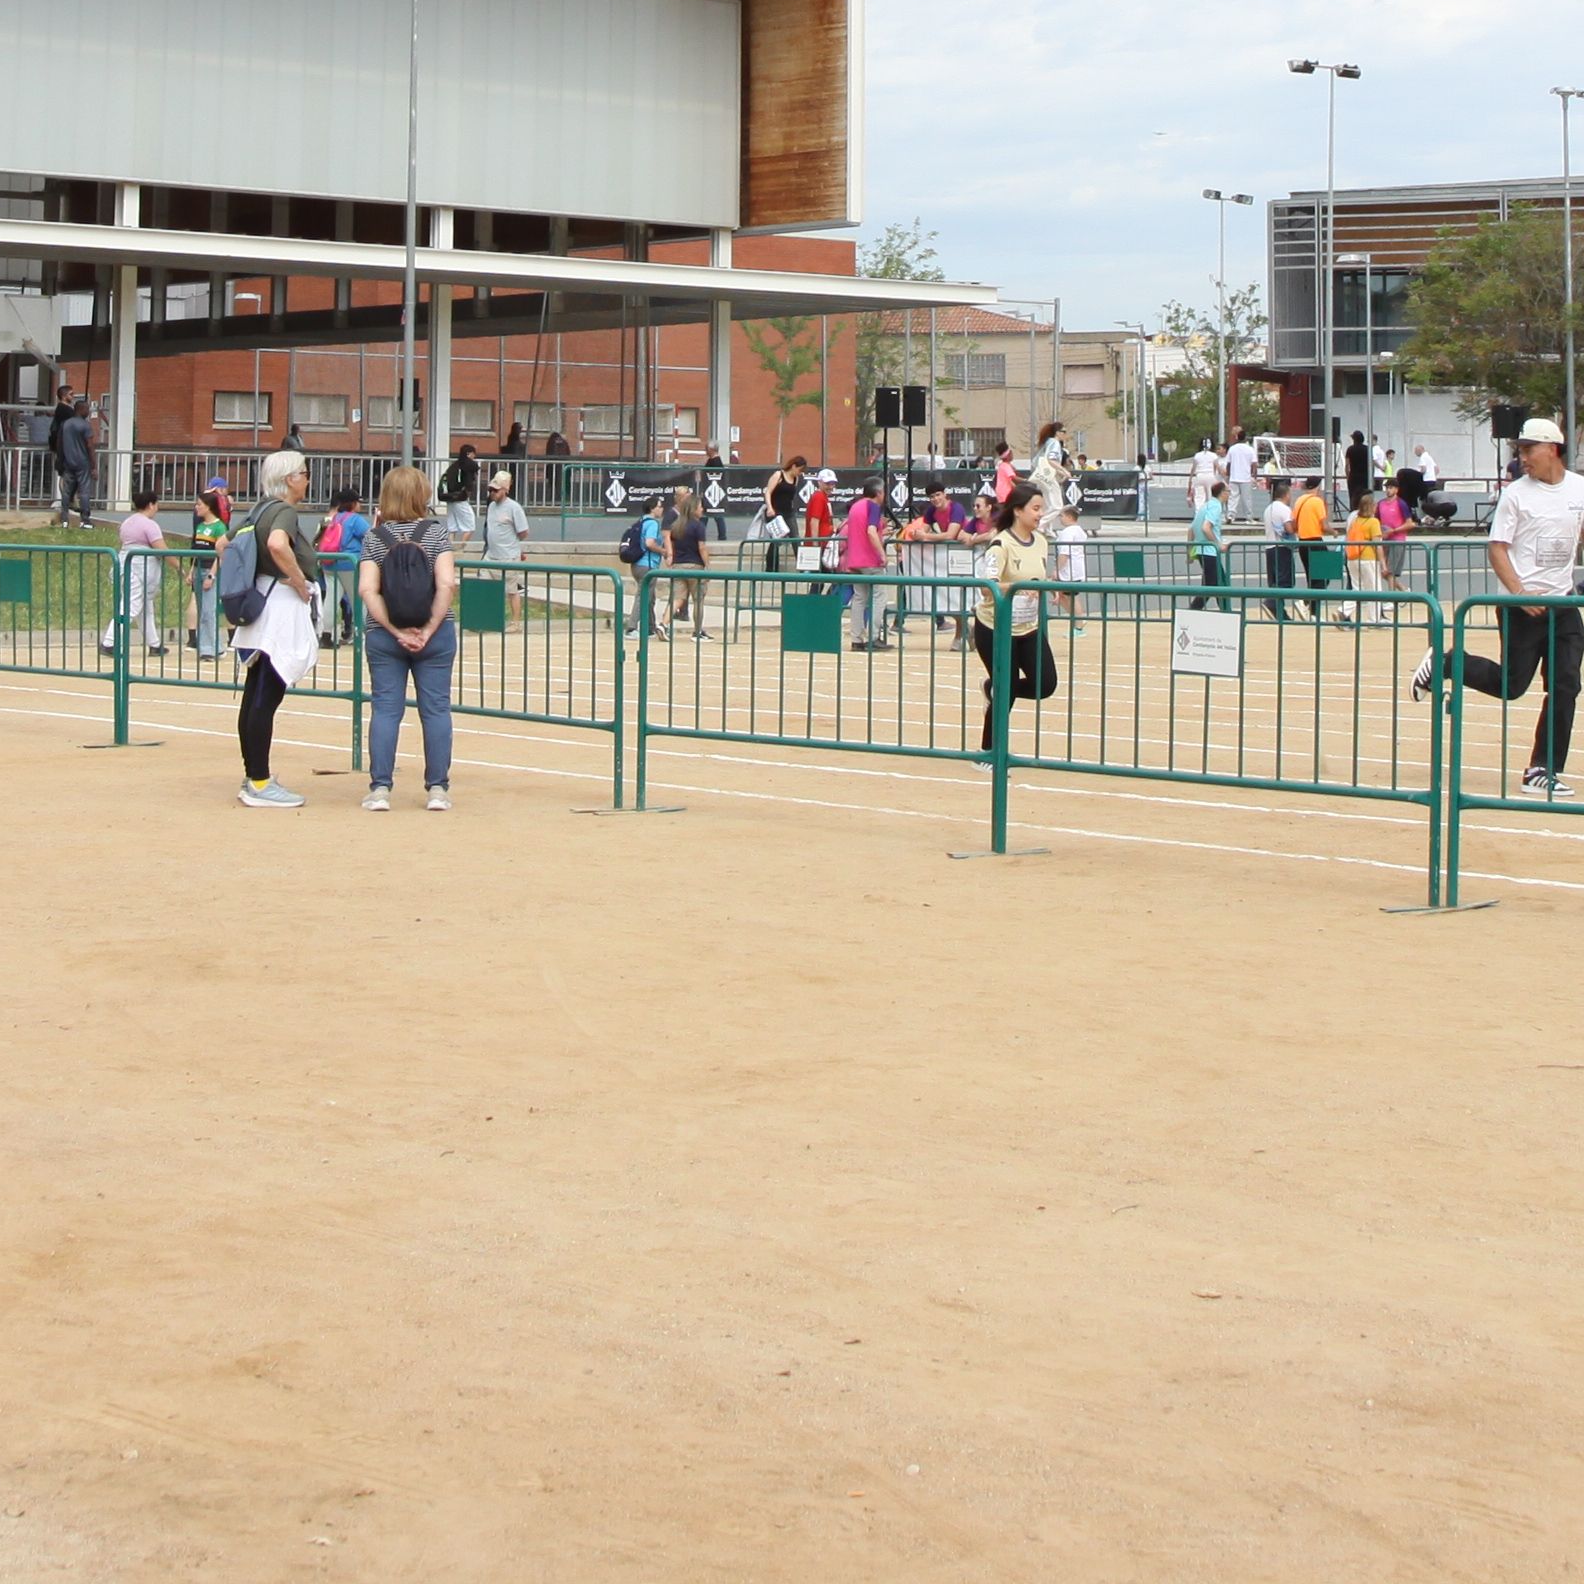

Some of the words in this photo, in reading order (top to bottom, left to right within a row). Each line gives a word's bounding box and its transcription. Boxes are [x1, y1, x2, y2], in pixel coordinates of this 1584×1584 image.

[628, 486, 663, 495] Cerdanyola
[664, 486, 674, 494] del
[726, 486, 762, 496] Cerdanyola
[1083, 487, 1113, 496] Cerdanyola
